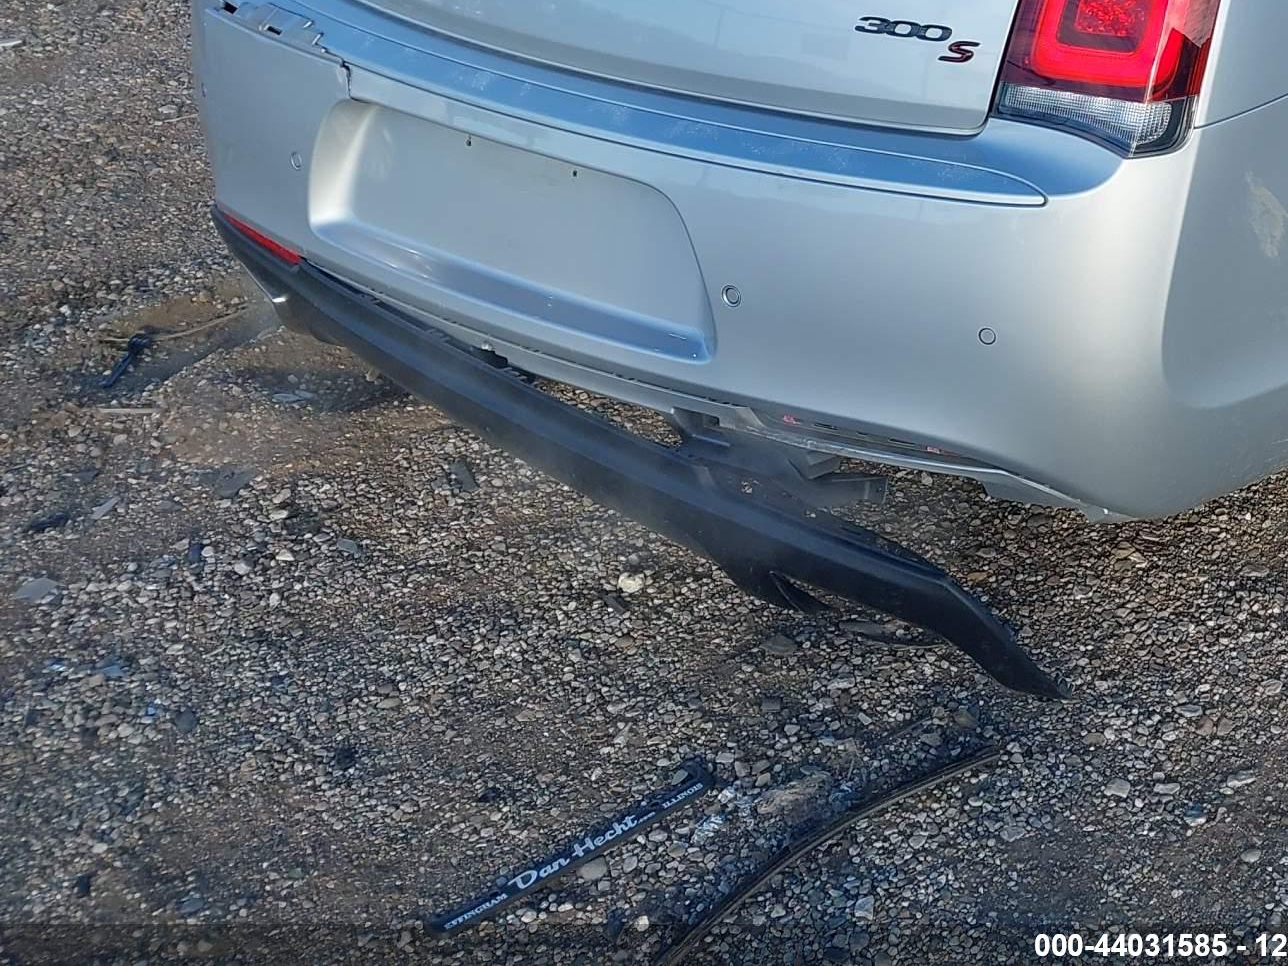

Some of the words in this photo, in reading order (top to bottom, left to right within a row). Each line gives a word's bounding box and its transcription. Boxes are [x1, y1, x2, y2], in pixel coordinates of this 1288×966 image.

[854, 15, 953, 42] 300
[937, 40, 982, 64] S
[507, 856, 570, 890] Dan
[661, 782, 704, 810] ILLINOIS
